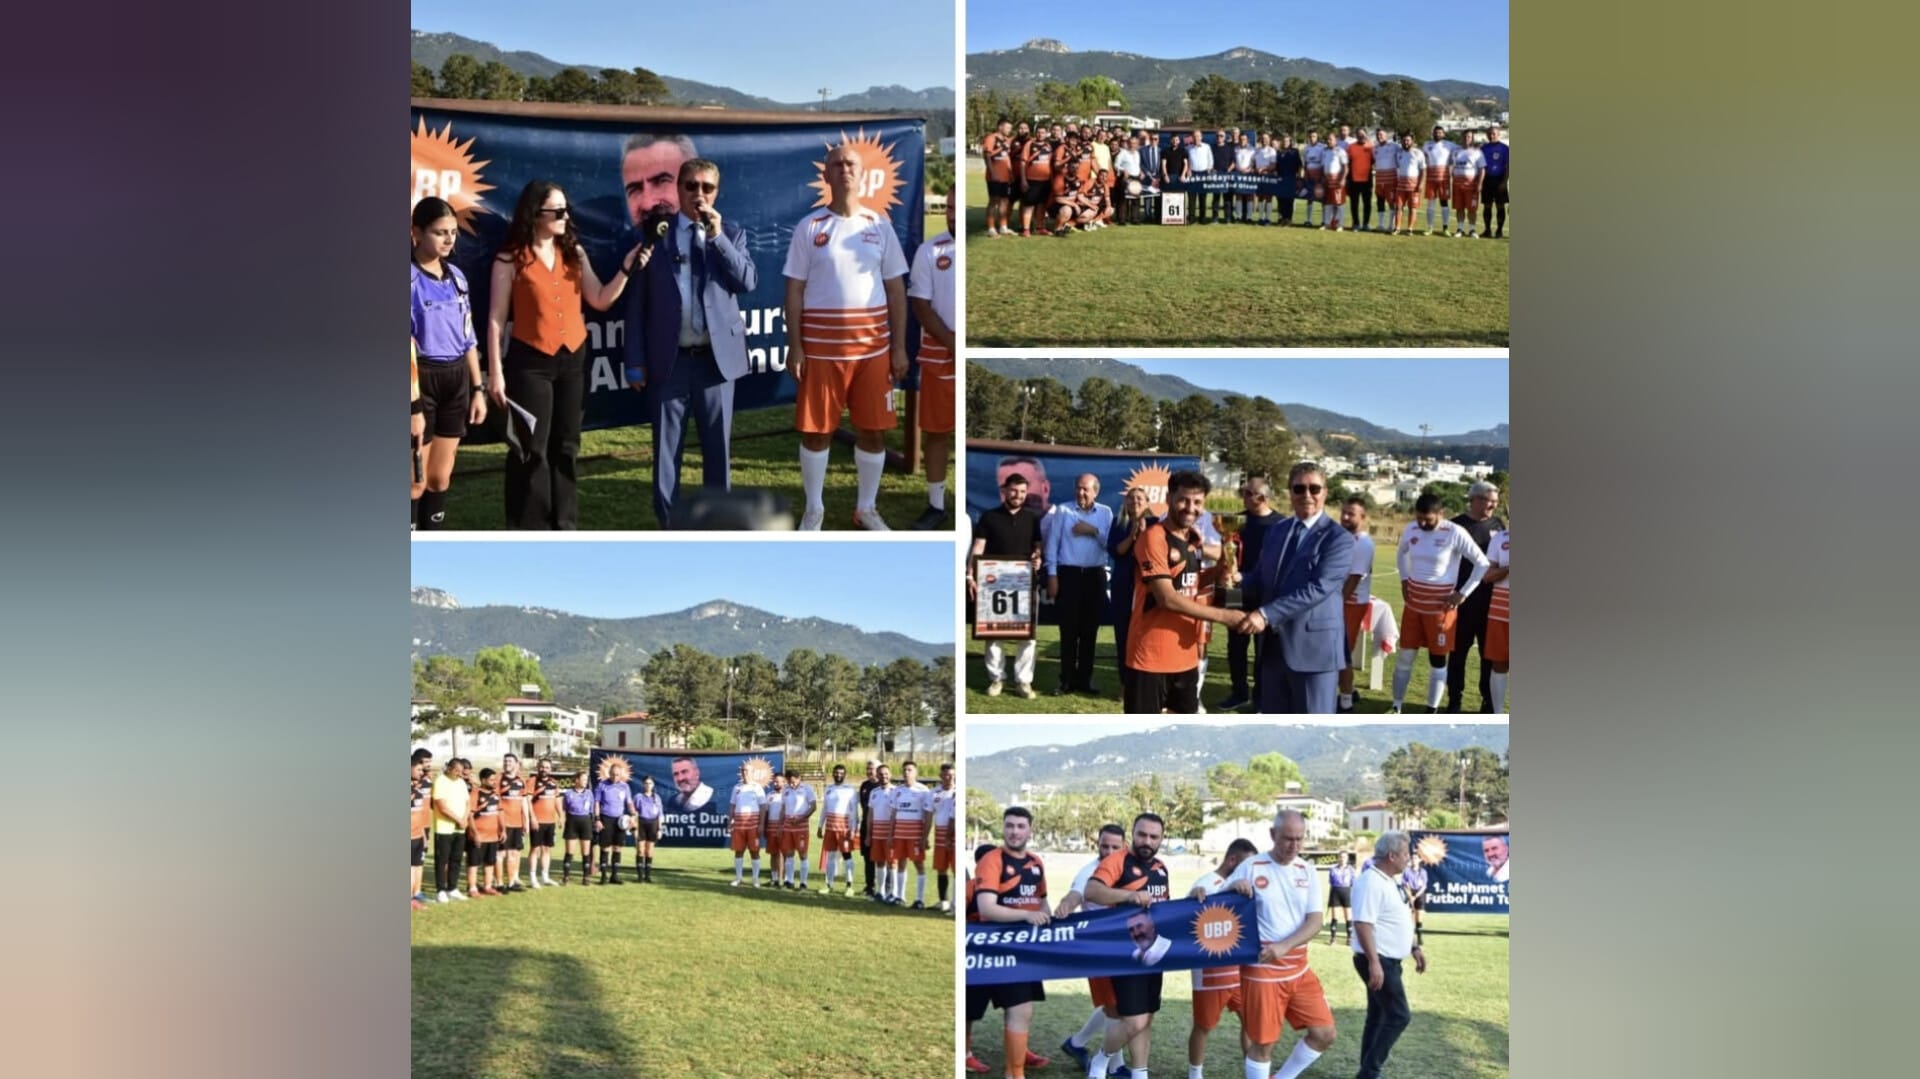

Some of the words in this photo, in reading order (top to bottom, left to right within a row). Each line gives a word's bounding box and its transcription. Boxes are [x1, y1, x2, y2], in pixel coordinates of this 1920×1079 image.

[1168, 205, 1180, 216] 61
[992, 590, 1019, 615] 61
[1147, 885, 1167, 896] UBP
[1447, 882, 1504, 894] Mehmet
[1425, 893, 1468, 904] Futbol
[1203, 920, 1232, 938] UBP
